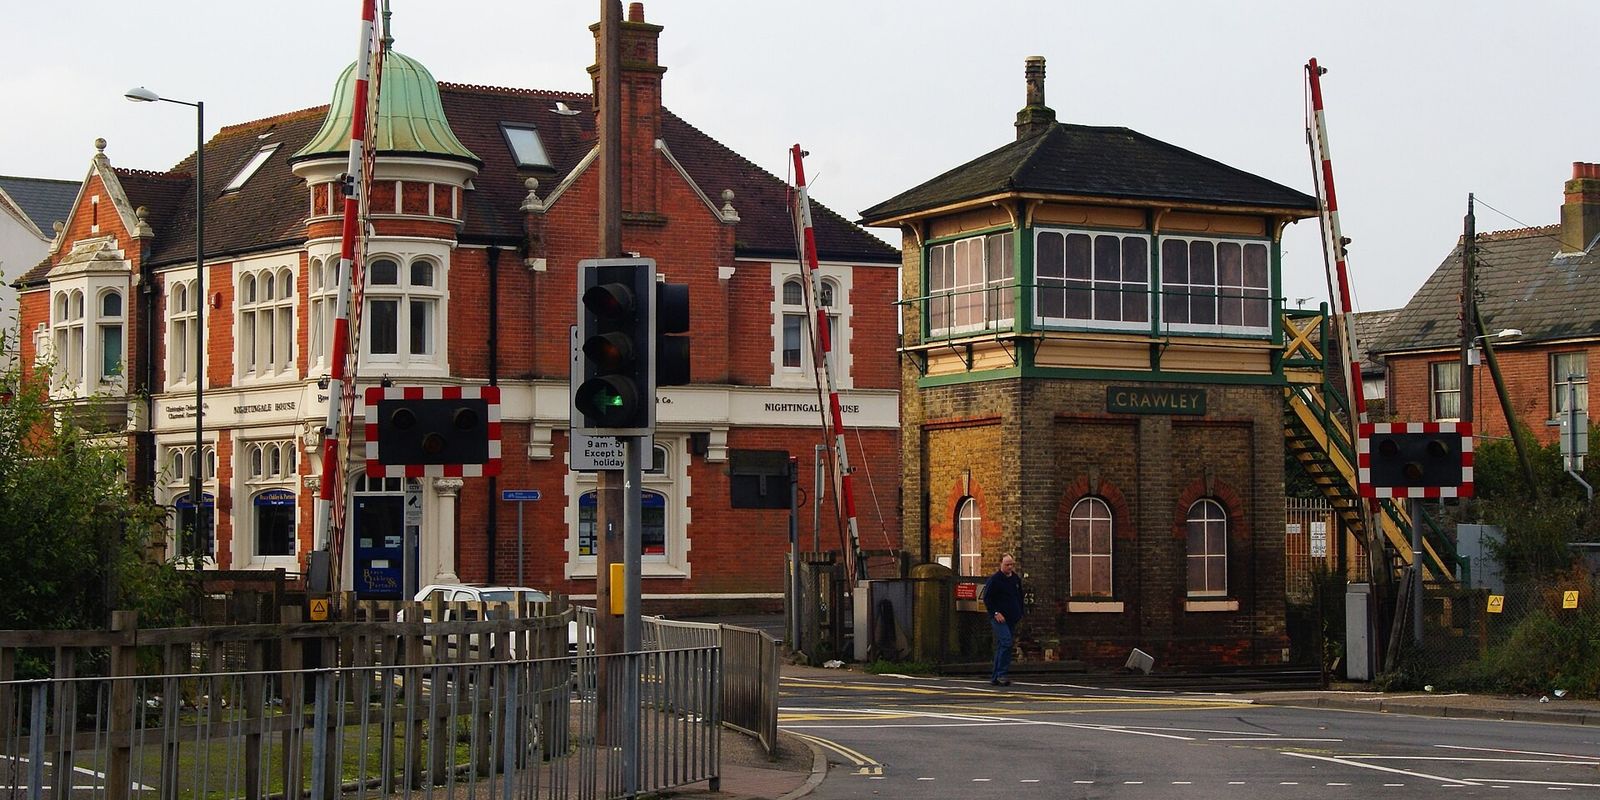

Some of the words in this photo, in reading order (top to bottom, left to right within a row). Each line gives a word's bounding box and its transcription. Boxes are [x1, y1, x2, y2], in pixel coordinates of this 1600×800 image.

[1115, 392, 1199, 409] CRAWLEY
[233, 403, 272, 414] NIGHTINGALE
[274, 401, 295, 411] HOUSE
[839, 404, 860, 413] USE
[587, 440, 593, 448] 9
[584, 449, 615, 458] Except
[593, 459, 625, 467] holiday
[625, 480, 631, 489] 4
[608, 523, 613, 531] 1
